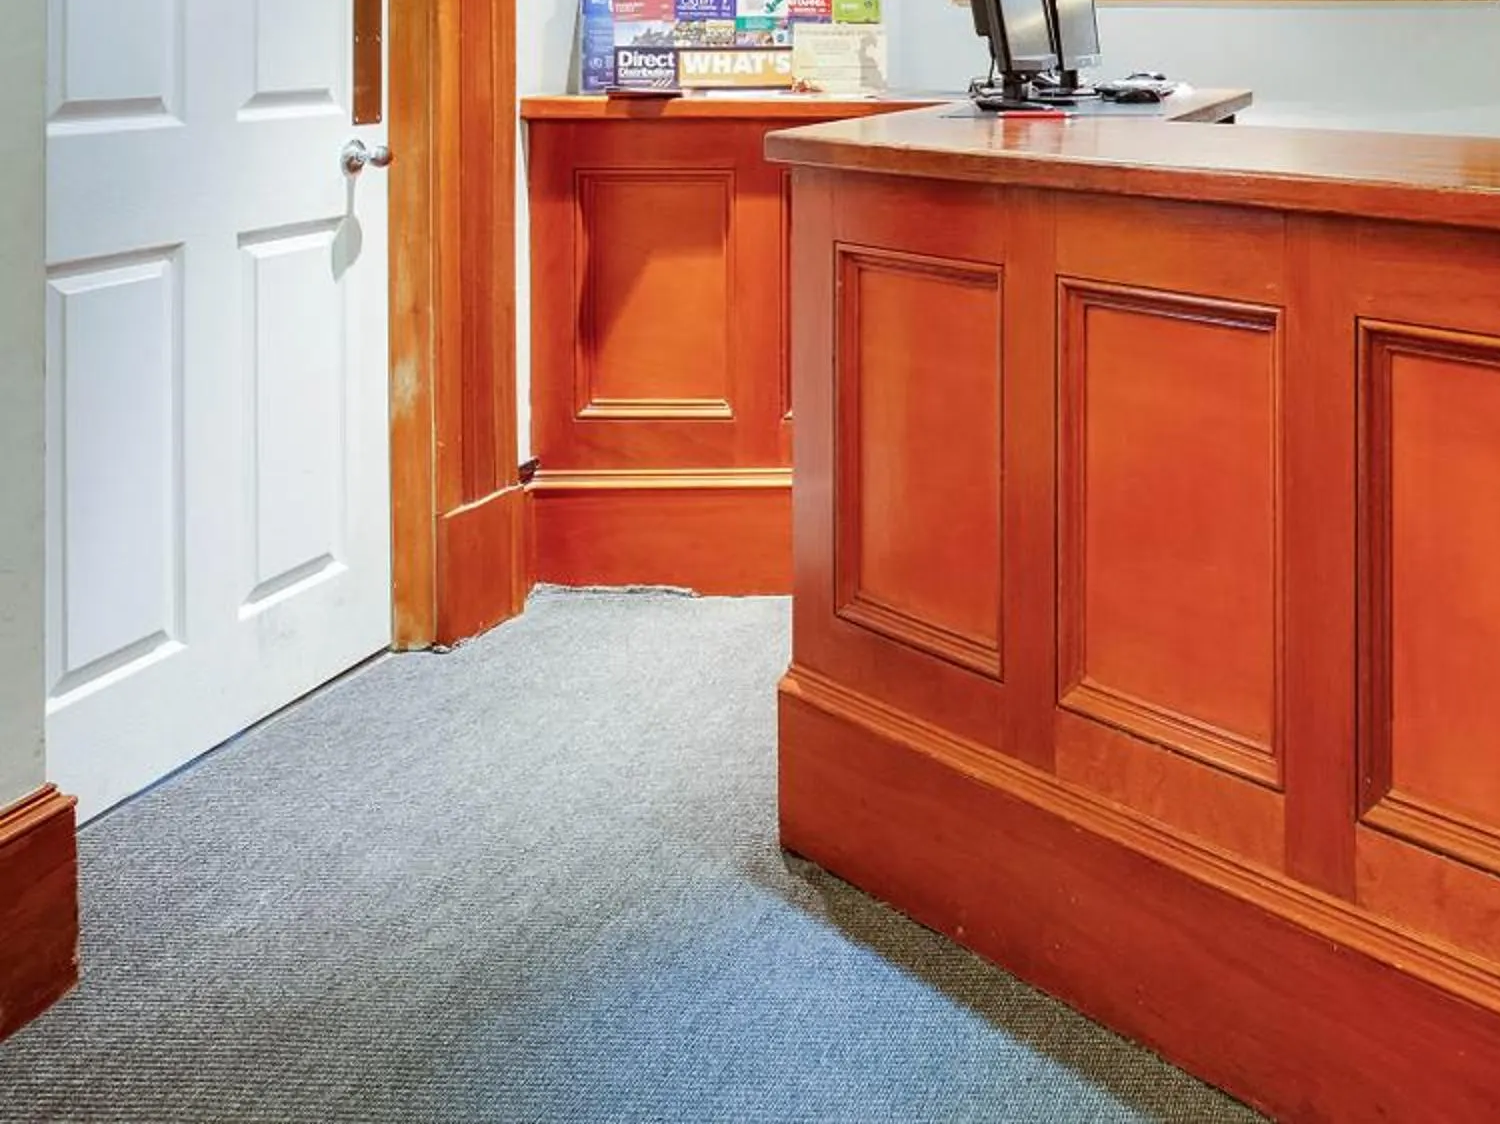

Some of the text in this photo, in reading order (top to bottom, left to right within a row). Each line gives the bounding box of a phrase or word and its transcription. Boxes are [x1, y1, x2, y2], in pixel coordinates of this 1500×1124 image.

[618, 50, 675, 68] Direct
[683, 50, 791, 75] WHAT'S
[618, 66, 675, 79] Distribution
